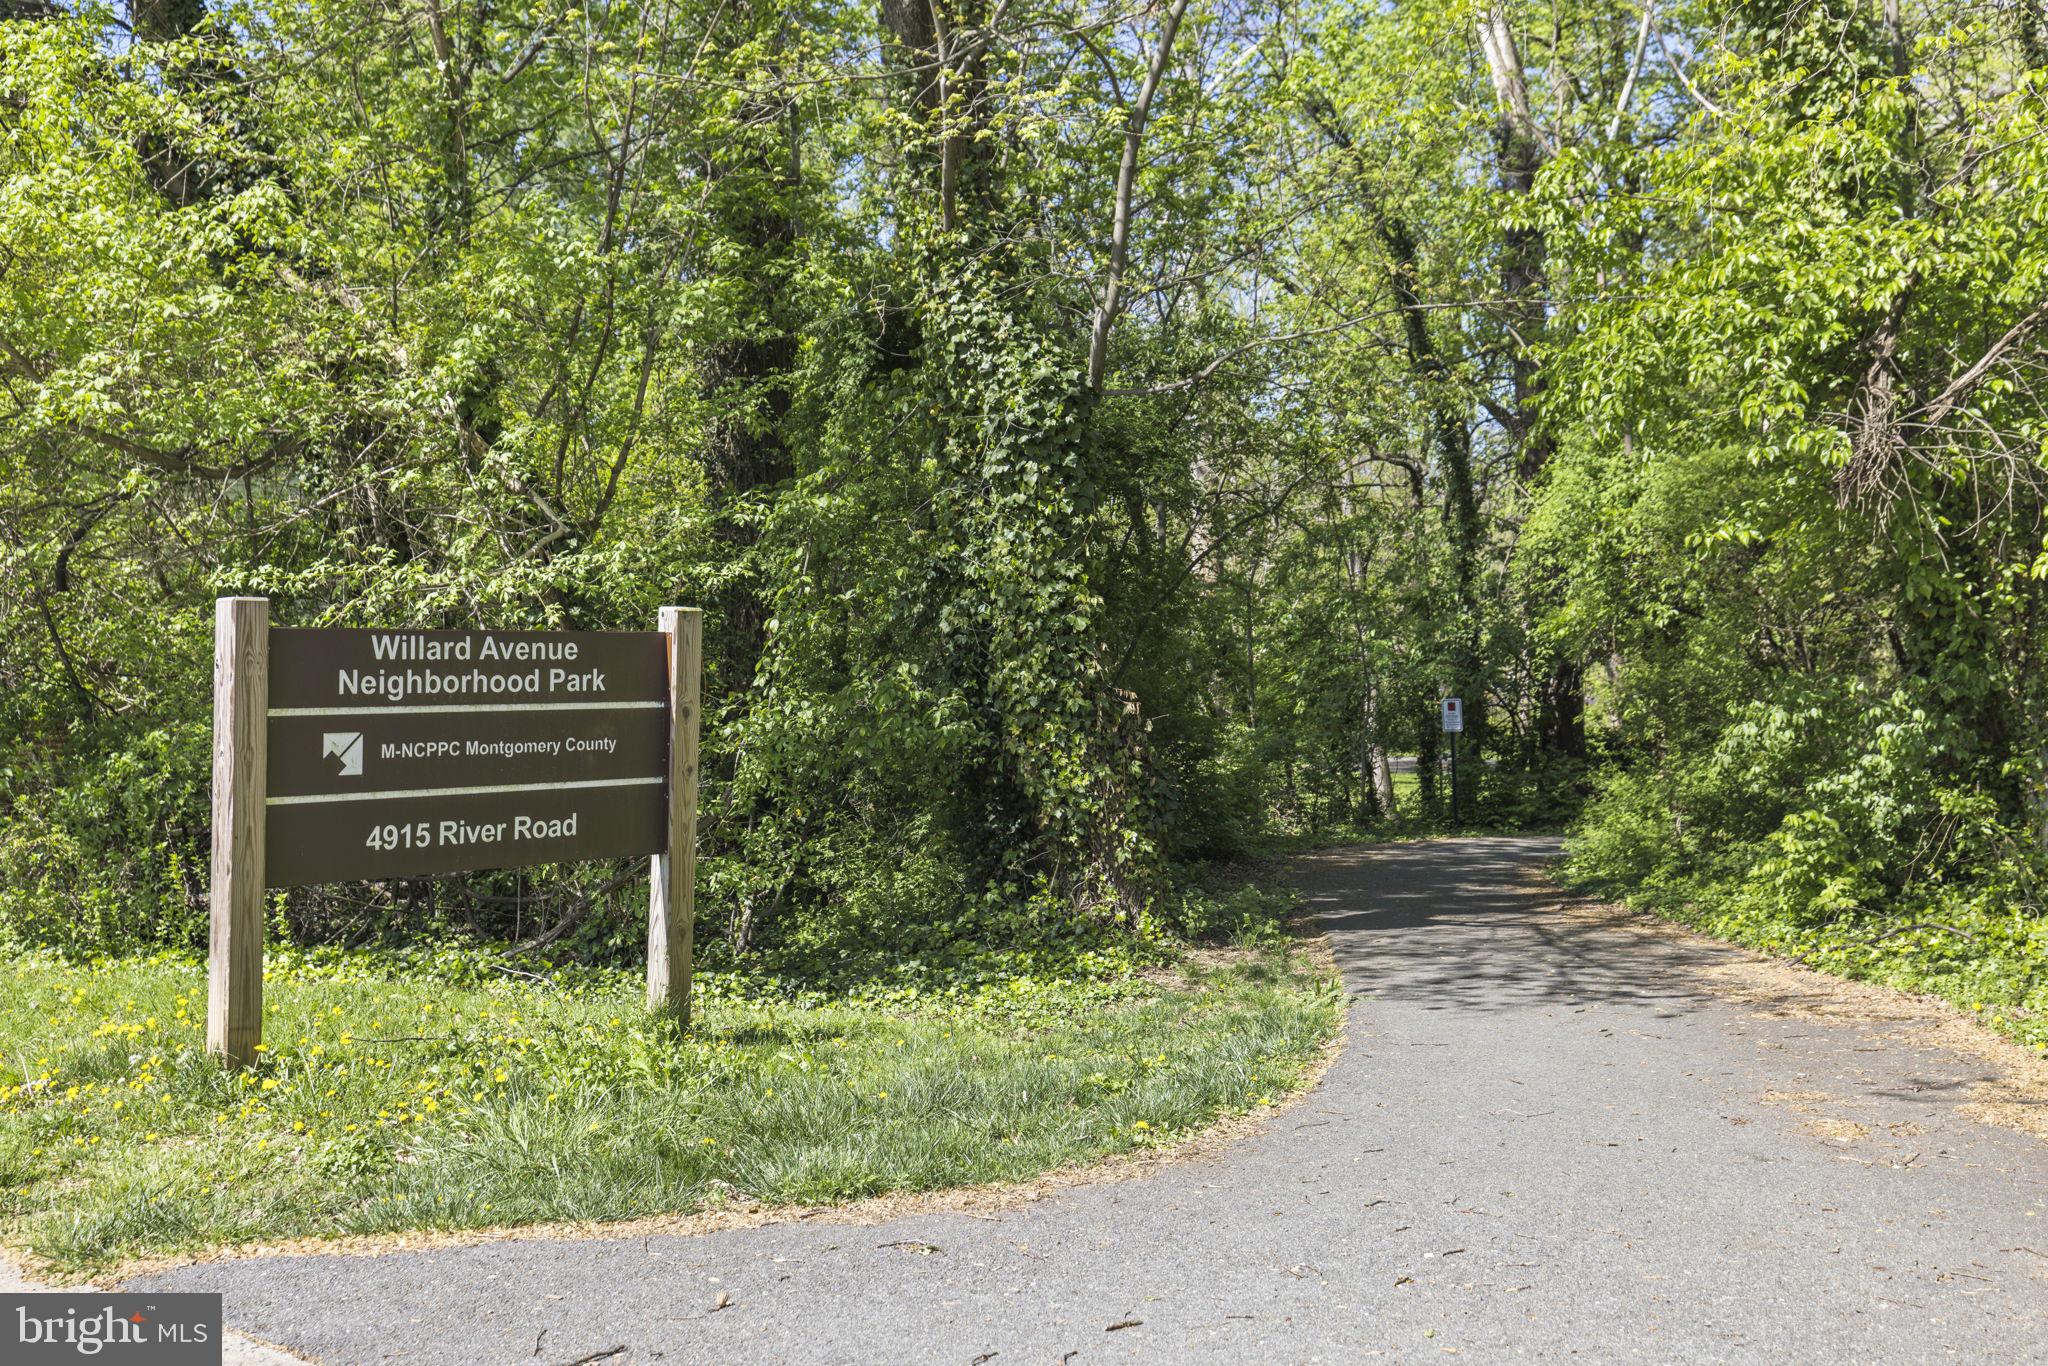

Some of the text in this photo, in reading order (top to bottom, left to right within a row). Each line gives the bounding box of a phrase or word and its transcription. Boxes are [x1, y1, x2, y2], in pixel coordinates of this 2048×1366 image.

[372, 635, 578, 661] Willard Avenue
[338, 668, 606, 700] Neighborhood Park
[381, 736, 617, 760] M-NCPPC Montgomery County
[366, 812, 577, 851] 4915 River Road
